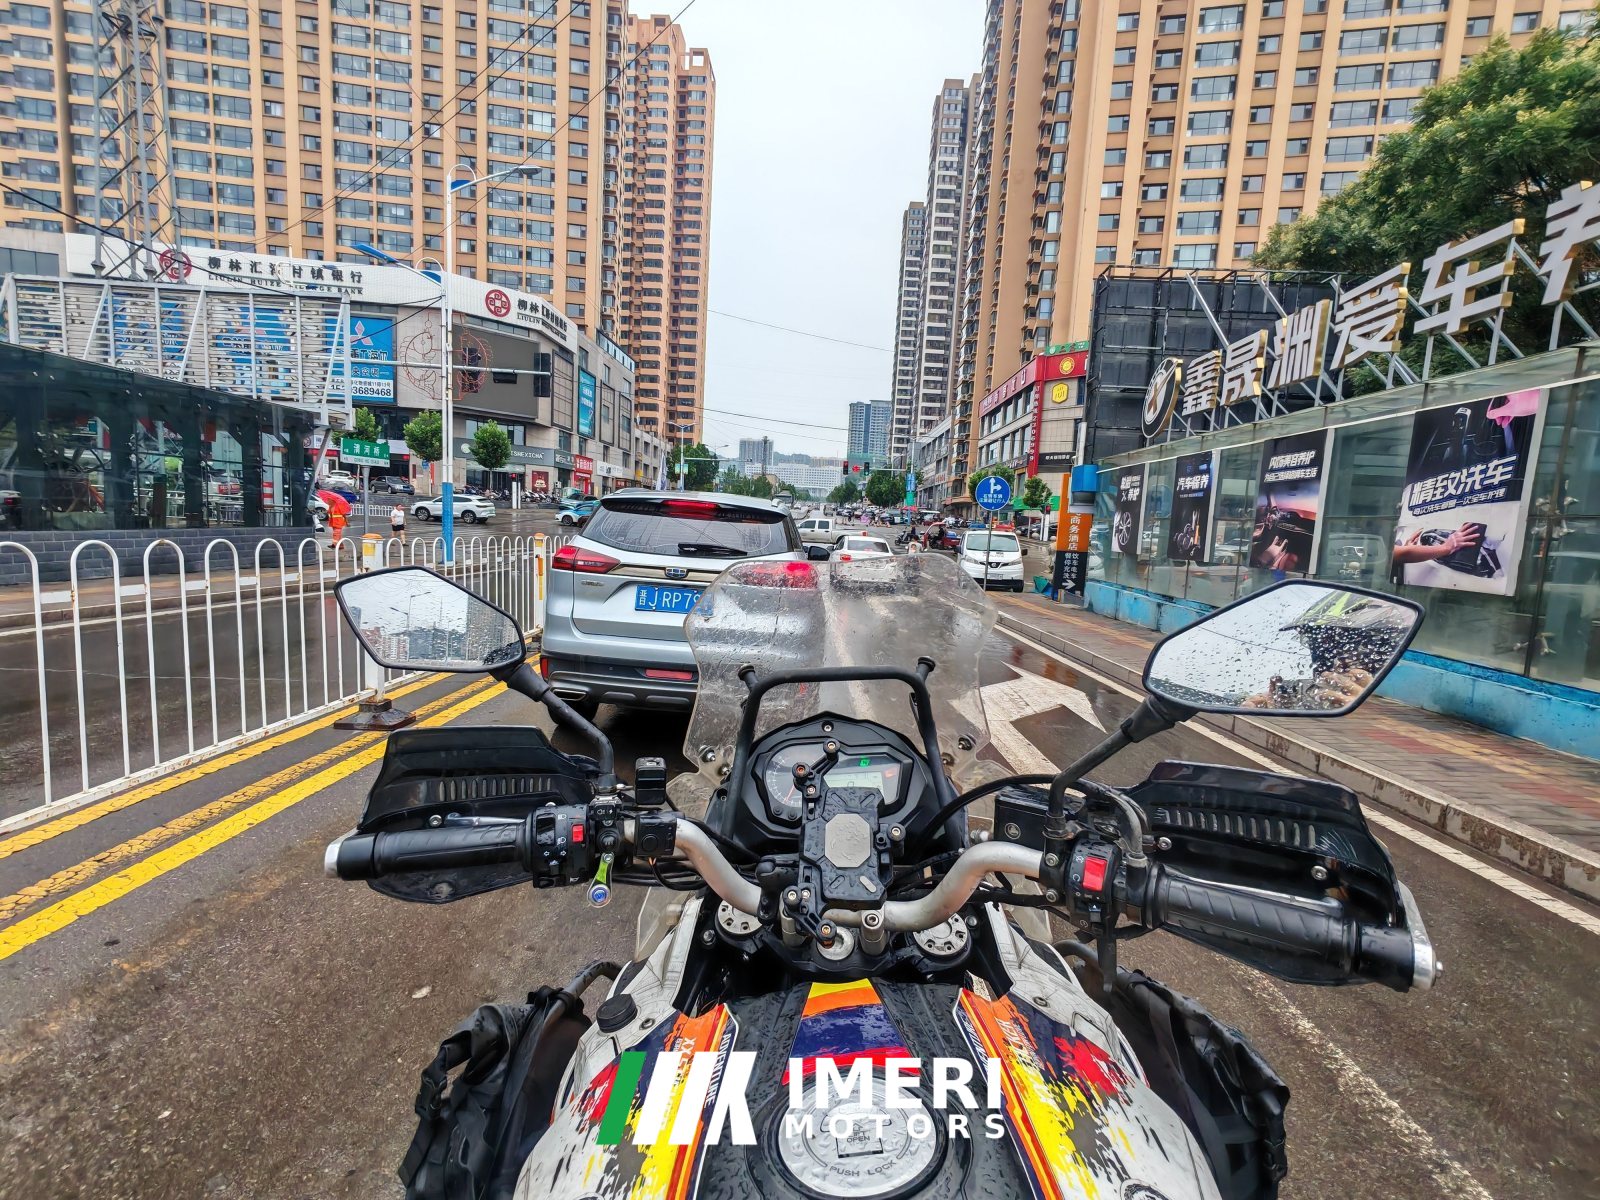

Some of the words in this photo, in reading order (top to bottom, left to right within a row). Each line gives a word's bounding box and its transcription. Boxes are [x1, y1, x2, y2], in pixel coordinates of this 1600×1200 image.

[337, 287, 363, 295] BANK
[516, 313, 541, 324] LIULIN
[1176, 474, 1209, 491] 汽车保养
[1409, 456, 1517, 506] 精致洗车
[1067, 513, 1081, 551] 商务酒店
[704, 1033, 732, 1109] ADVENTURE
[846, 1135, 870, 1143] OPEN
[829, 1165, 860, 1177] PUSH
[867, 1160, 897, 1176] LOCK
